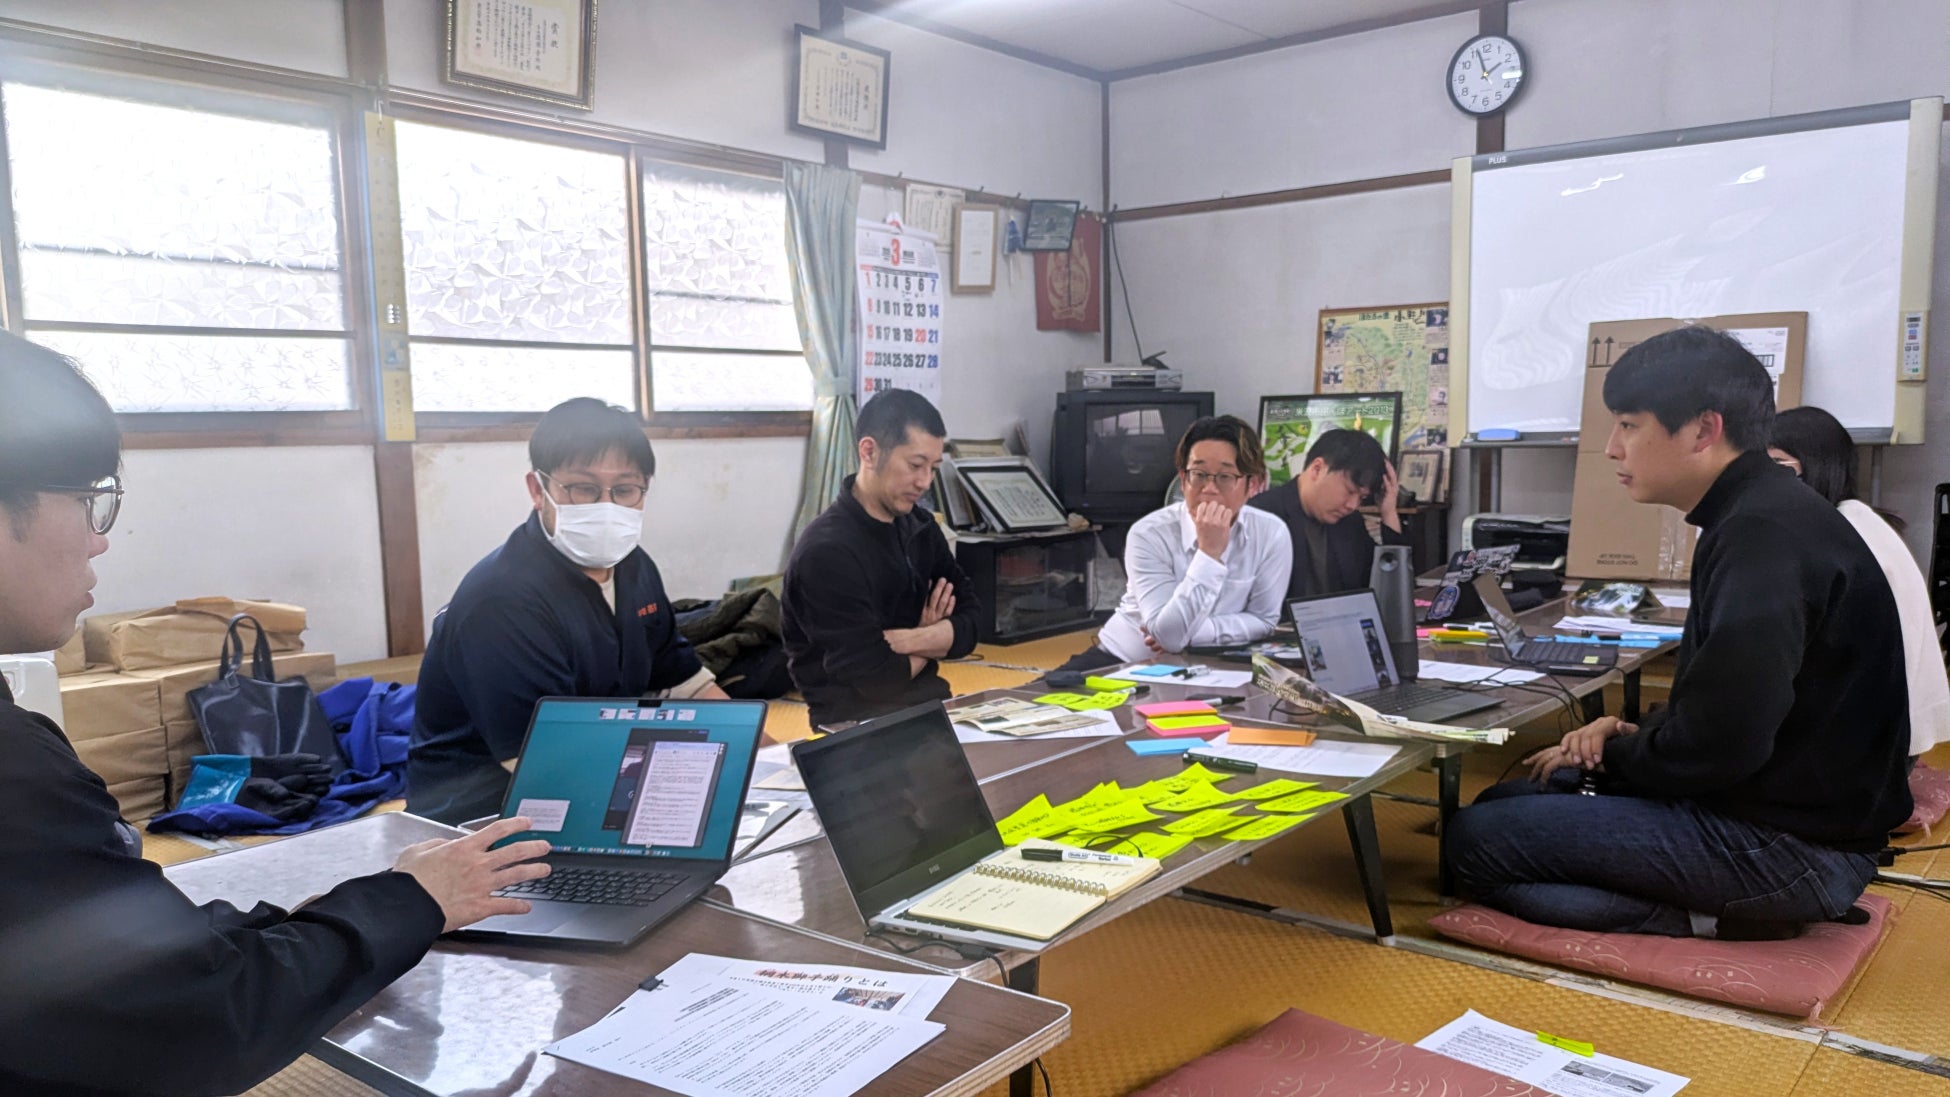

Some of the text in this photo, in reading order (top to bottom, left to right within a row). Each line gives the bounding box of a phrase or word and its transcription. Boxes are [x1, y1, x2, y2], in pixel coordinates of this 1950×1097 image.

[1482, 43, 1492, 53] 12
[1497, 45, 1501, 54] 1
[1471, 49, 1480, 59] 11
[1504, 53, 1511, 63] 2
[1461, 60, 1471, 70] 10
[1458, 75, 1465, 84] 9
[1503, 81, 1511, 89] 4
[1461, 87, 1469, 97] 8
[1494, 91, 1502, 101] 5
[1471, 95, 1478, 104] 7
[1481, 97, 1489, 106] 6
[1488, 156, 1507, 165] PLUS
[890, 238, 900, 266] 3
[865, 272, 870, 286] 1
[877, 273, 881, 287] 2
[885, 275, 889, 289] 3
[893, 276, 898, 290] 4
[905, 277, 911, 291] 5
[918, 278, 924, 292] 6
[931, 279, 936, 293] 7
[883, 301, 890, 315] 10
[893, 302, 900, 316] 11
[903, 303, 913, 317] 12
[916, 304, 926, 318] 13
[929, 304, 939, 318] 14
[876, 326, 882, 340] 16
[883, 327, 890, 341] 17
[892, 327, 900, 342] 18
[903, 328, 913, 342] 19
[915, 328, 926, 343] 20
[928, 329, 938, 344] 21
[874, 352, 882, 366] 23
[883, 352, 891, 367] 24
[892, 353, 901, 368] 25
[903, 354, 914, 368] 26
[915, 354, 925, 368] 27
[927, 354, 938, 369] 28
